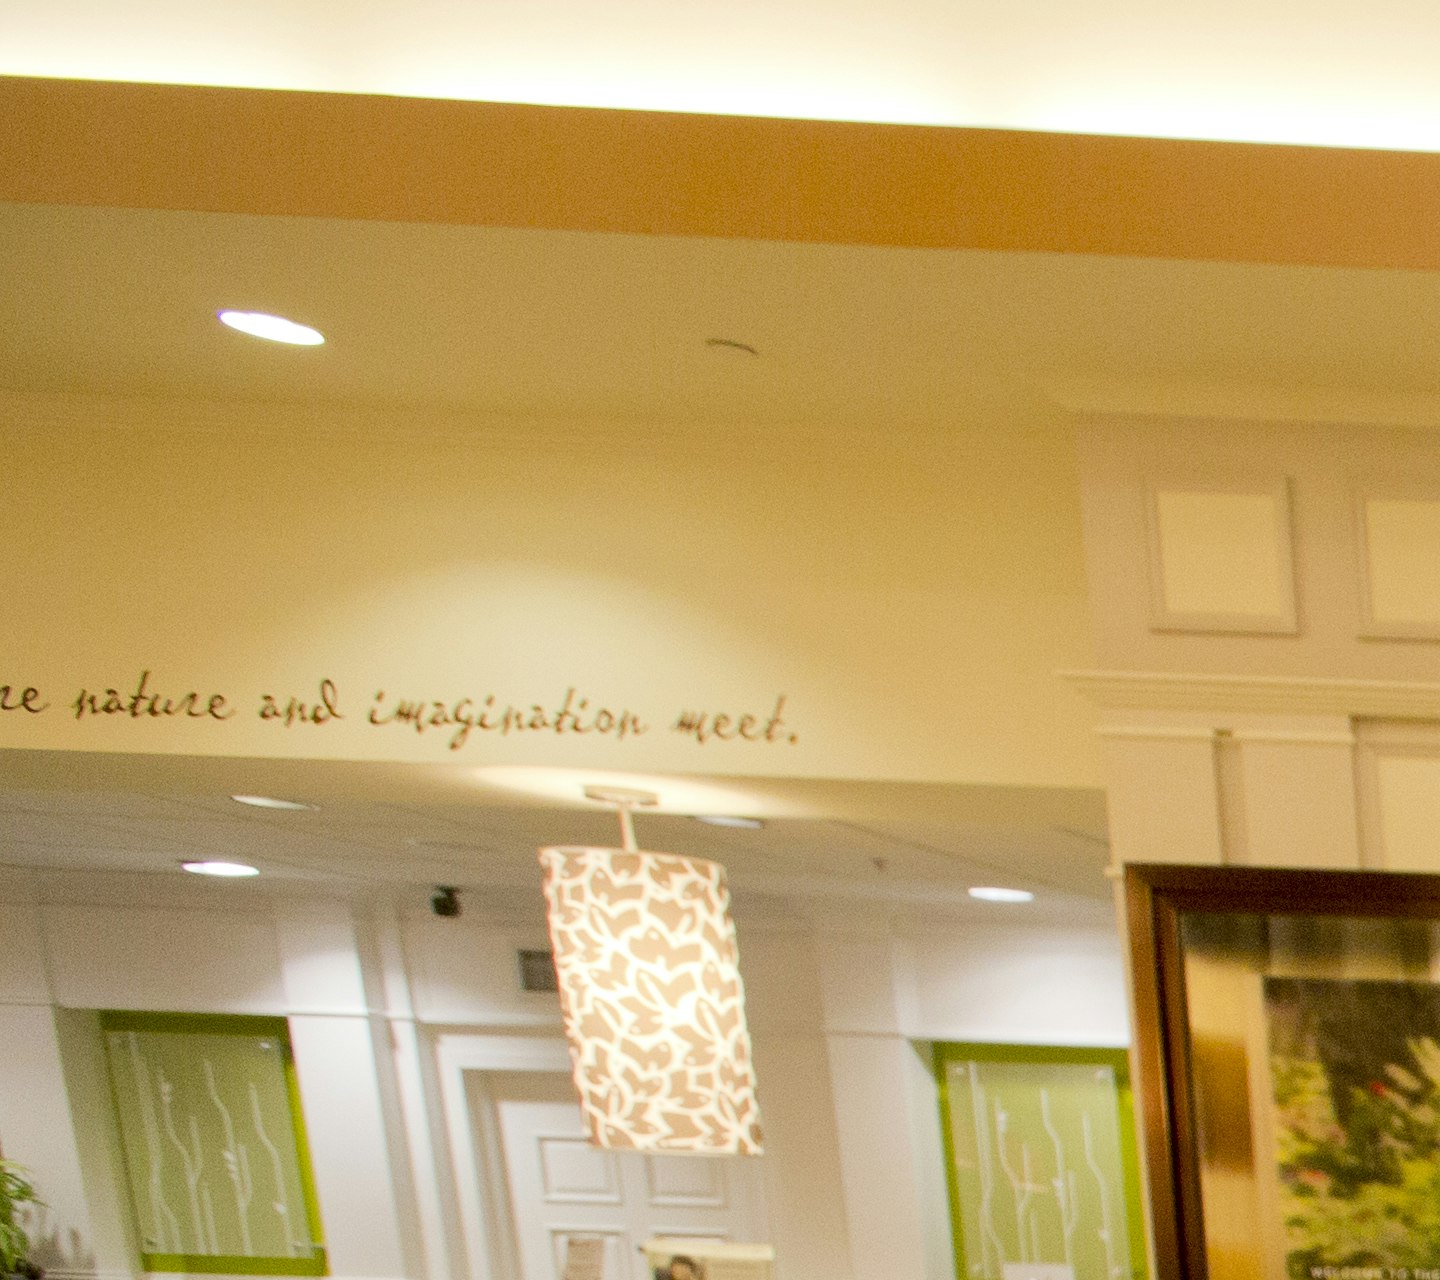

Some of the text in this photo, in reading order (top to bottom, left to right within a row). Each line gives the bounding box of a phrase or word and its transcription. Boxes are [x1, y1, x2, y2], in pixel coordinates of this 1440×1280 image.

[72, 670, 237, 721] nature
[258, 678, 346, 728] and
[367, 686, 650, 751] imagination
[673, 693, 799, 746] meet.
